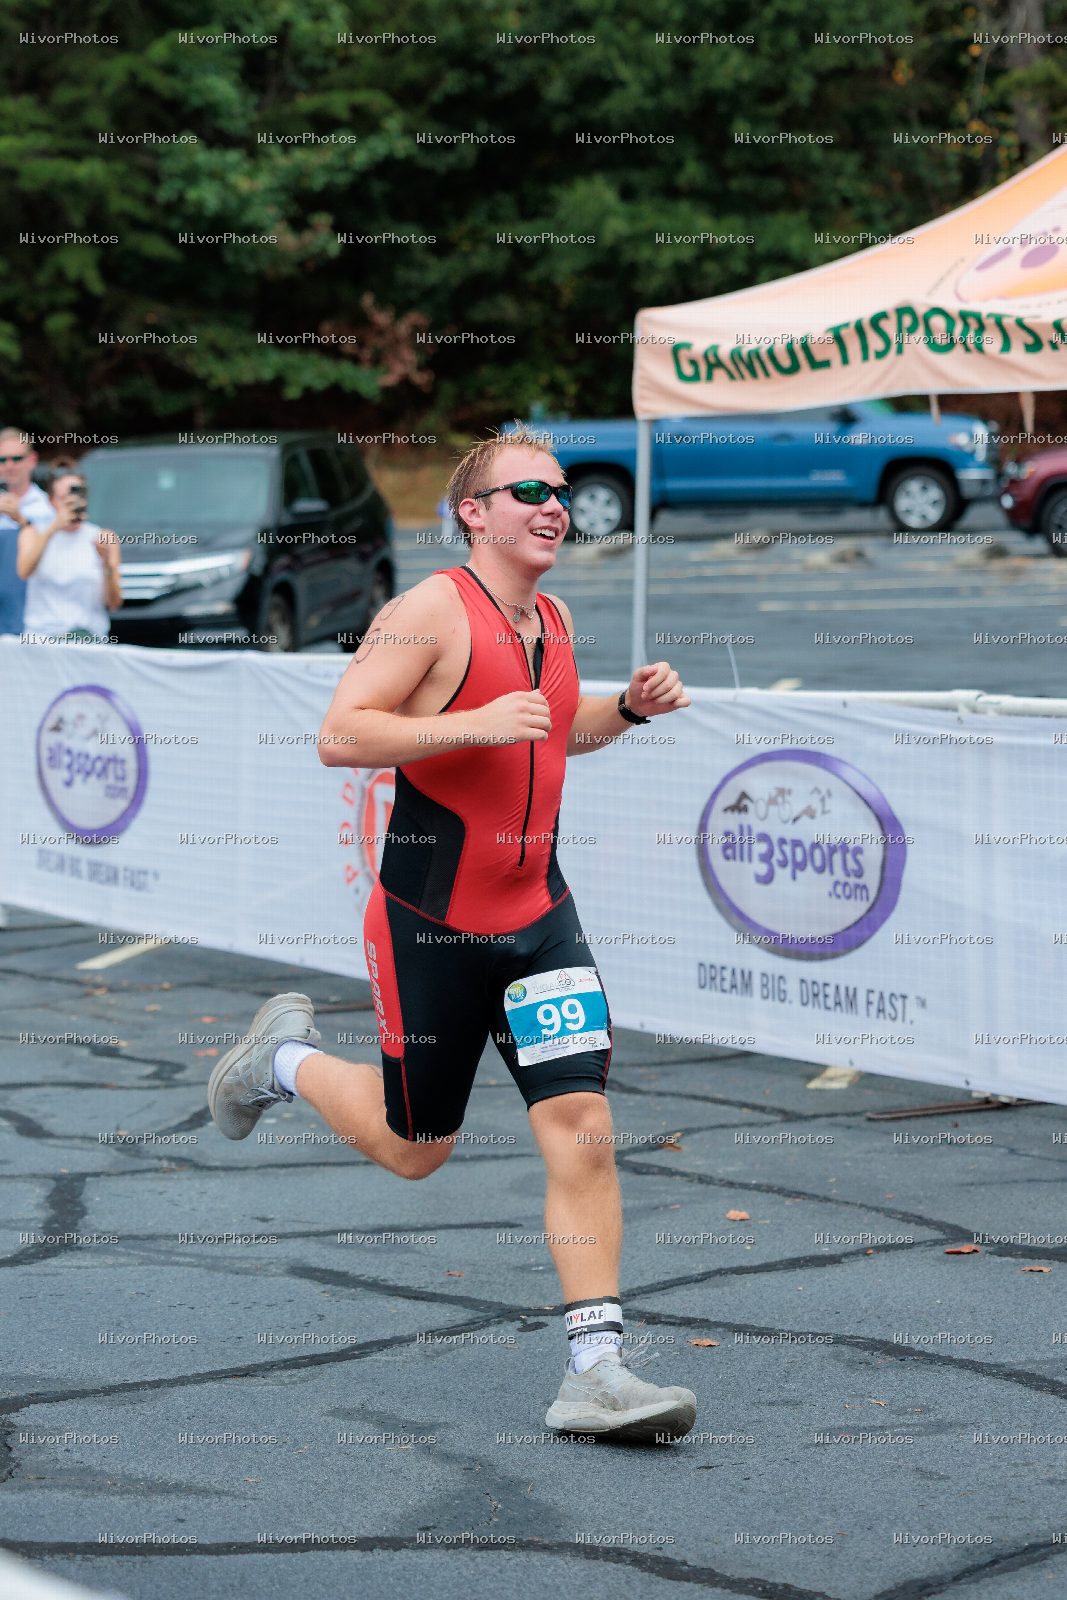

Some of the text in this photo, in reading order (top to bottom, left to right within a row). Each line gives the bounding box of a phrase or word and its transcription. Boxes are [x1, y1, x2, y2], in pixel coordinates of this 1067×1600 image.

[721, 823, 865, 886] all3sports
[828, 880, 870, 902] .com
[697, 962, 753, 998] DREAM
[760, 972, 793, 1005] BIG.
[799, 978, 858, 1016] DREAM
[536, 998, 586, 1036] 99
